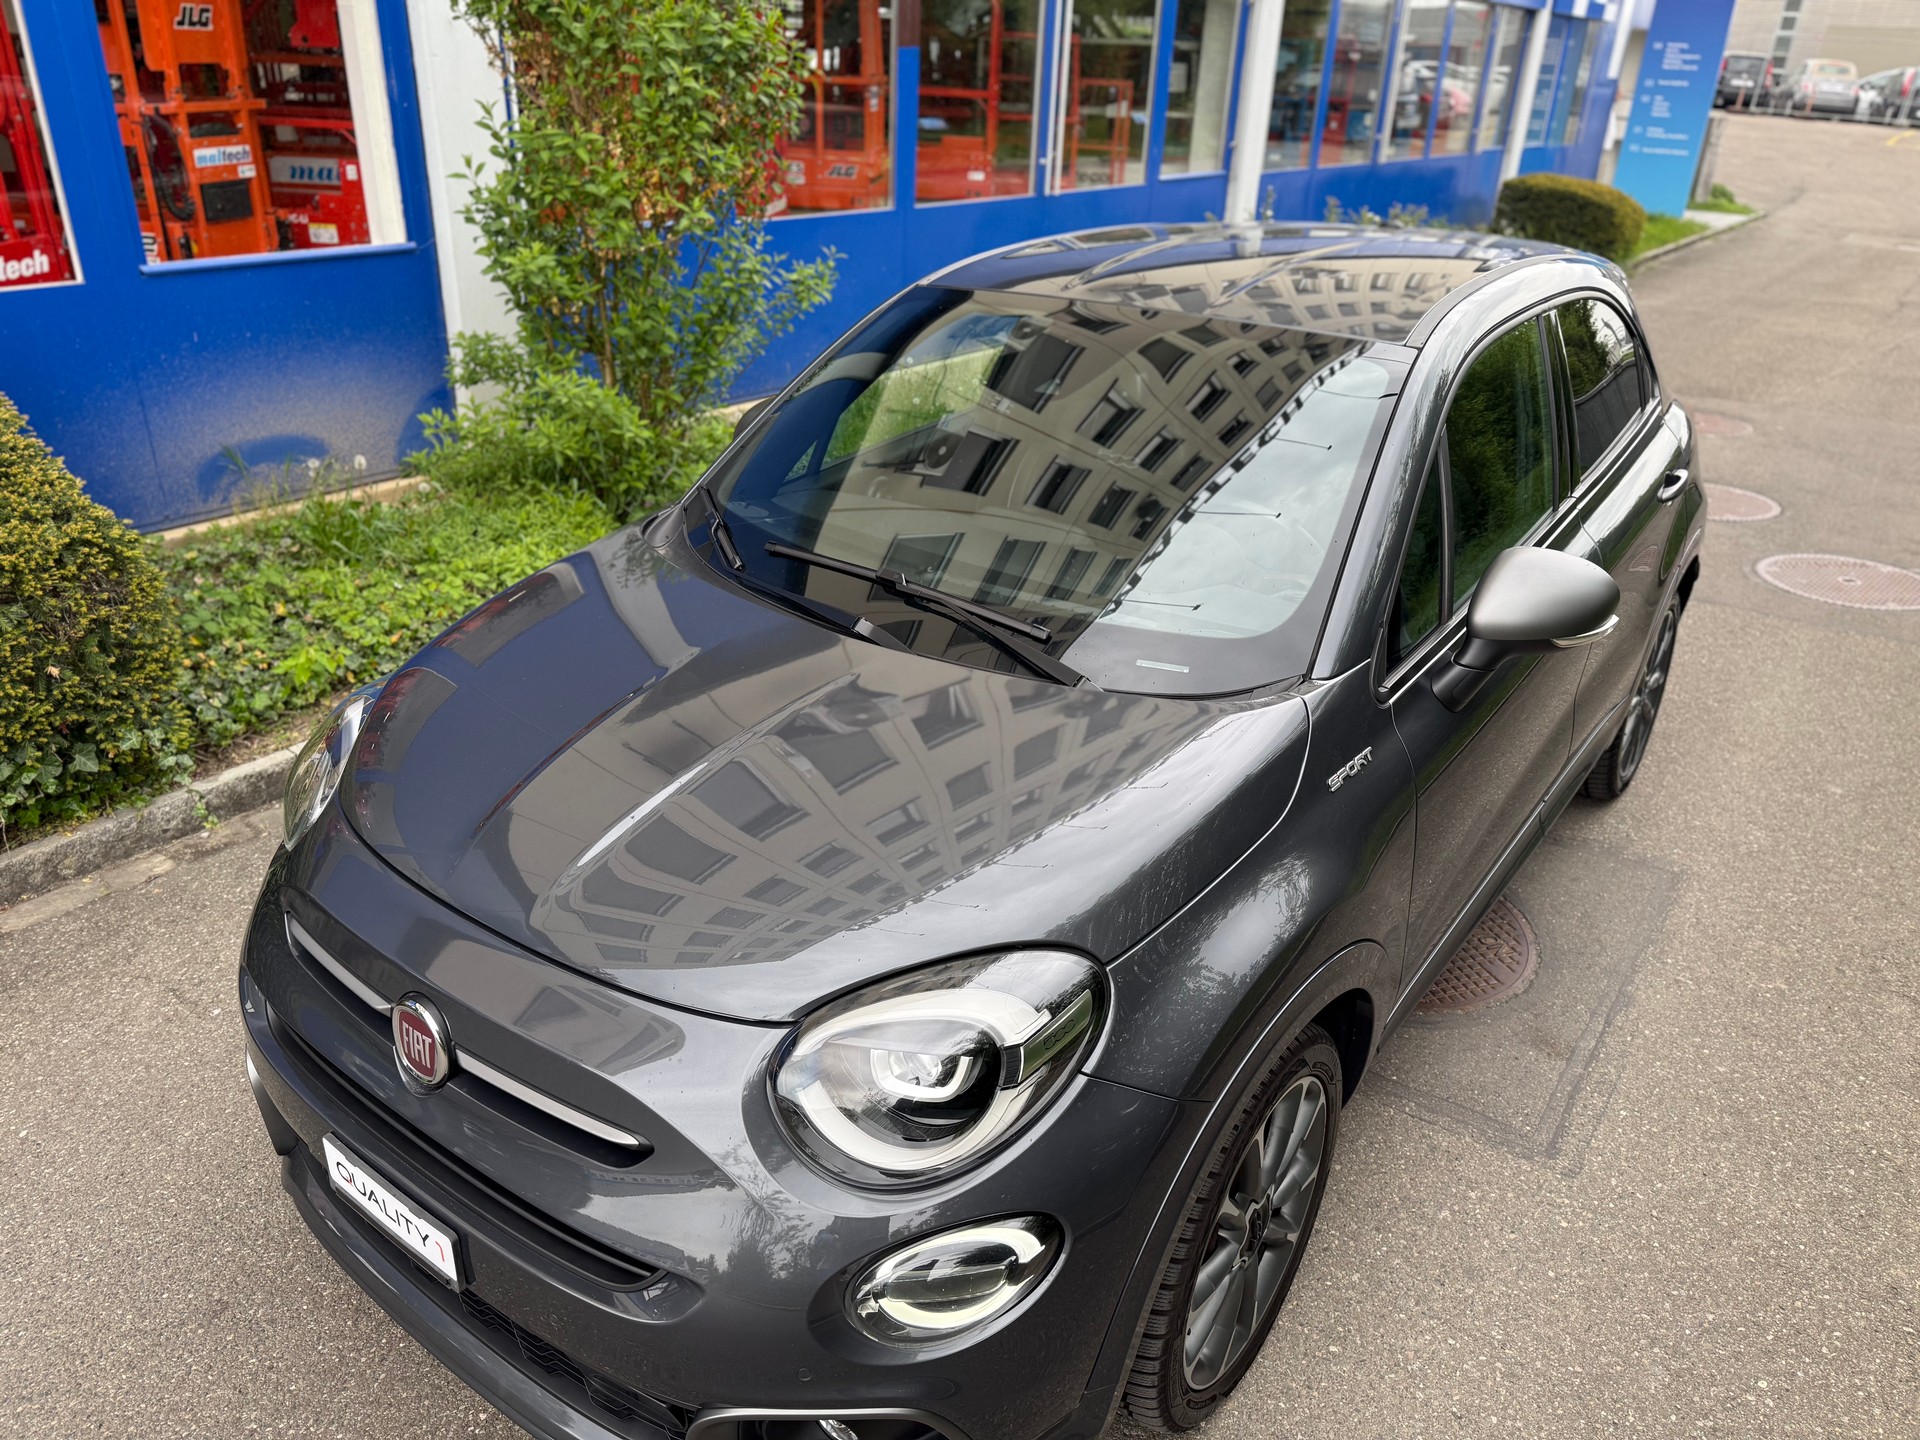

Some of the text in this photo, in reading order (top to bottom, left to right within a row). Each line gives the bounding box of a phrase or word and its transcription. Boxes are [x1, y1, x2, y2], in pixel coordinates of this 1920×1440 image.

[176, 5, 210, 27] JLG
[828, 164, 857, 178] JLG
[1327, 746, 1373, 792] SPORT
[402, 1020, 432, 1069] FIAT
